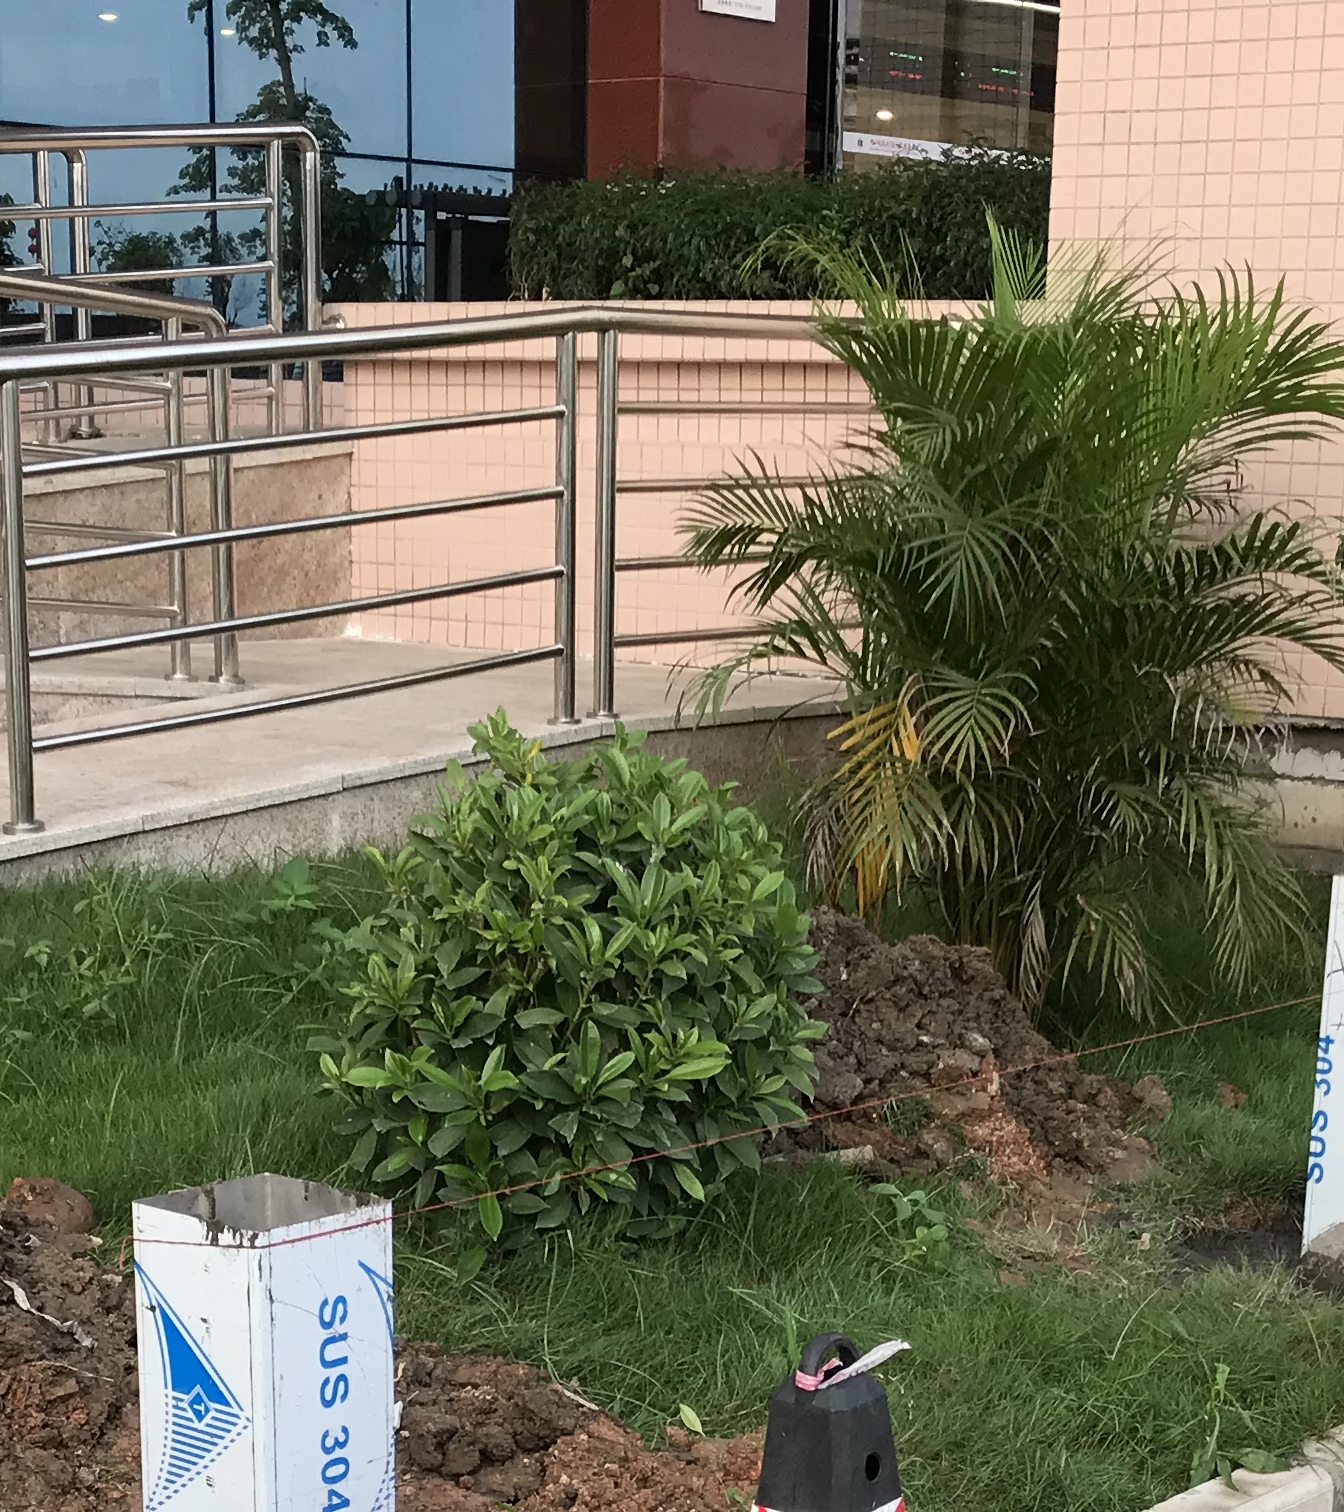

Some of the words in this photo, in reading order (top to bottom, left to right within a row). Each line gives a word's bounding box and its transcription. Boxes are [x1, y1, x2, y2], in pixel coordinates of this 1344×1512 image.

[1314, 1034, 1335, 1097] 304
[1306, 1109, 1329, 1184] SUS
[318, 1295, 349, 1409] SUS
